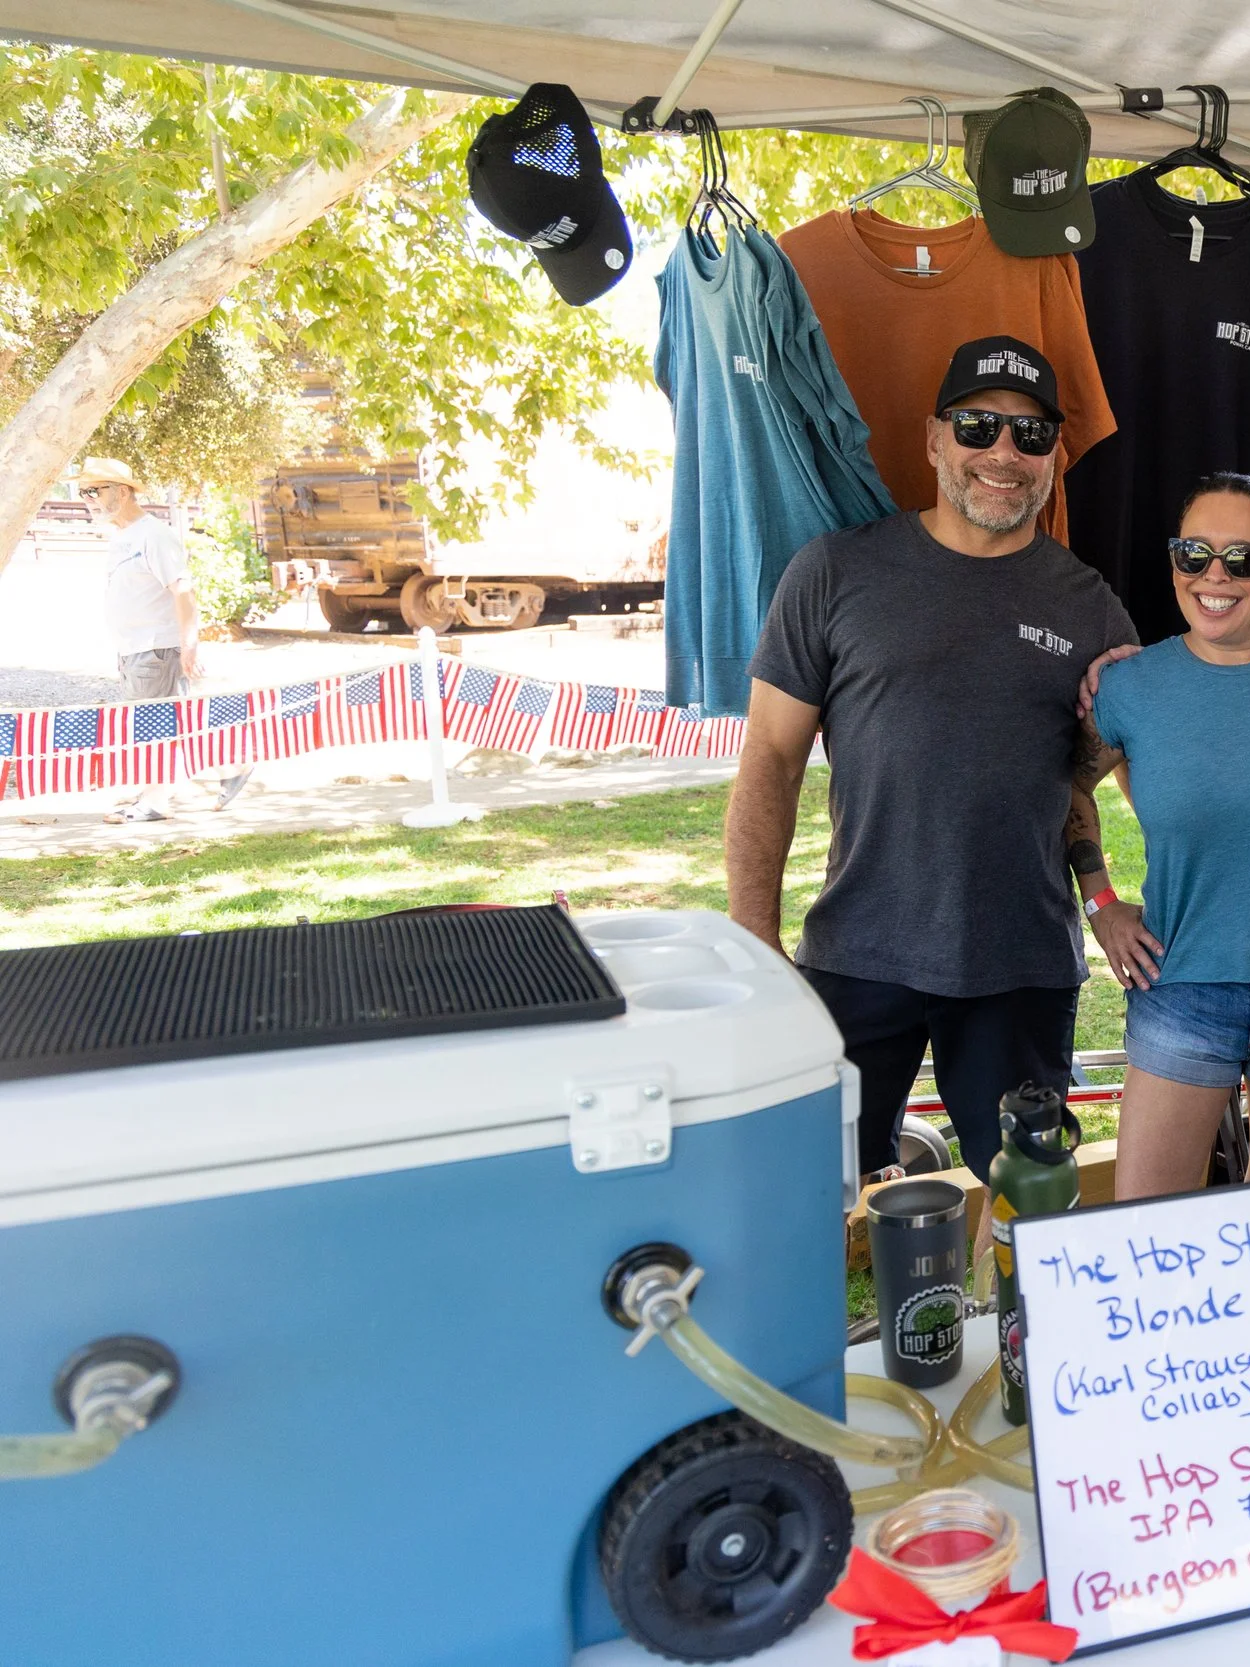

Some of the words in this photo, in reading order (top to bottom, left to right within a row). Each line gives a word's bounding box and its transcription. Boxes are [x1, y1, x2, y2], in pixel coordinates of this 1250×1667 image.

[1012, 177, 1038, 196] HOP
[1040, 171, 1068, 195] STOP
[1036, 169, 1048, 179] THE
[1216, 321, 1240, 340] HOP
[976, 358, 1005, 376] HOP
[1007, 360, 1040, 383] STOP
[1003, 350, 1018, 362] THE
[1018, 624, 1043, 643] HOP
[1045, 632, 1073, 656] STOP
[909, 1248, 956, 1277] JON
[1128, 1236, 1206, 1280] Hop
[1097, 1291, 1245, 1340] Blonde
[904, 1333, 933, 1352] HOP
[1053, 1361, 1136, 1416] (Karl
[1057, 1474, 1133, 1513] The
[1139, 1453, 1219, 1494] Hop
[1130, 1500, 1214, 1544] IPA
[1071, 1557, 1238, 1618] (Burgeon
